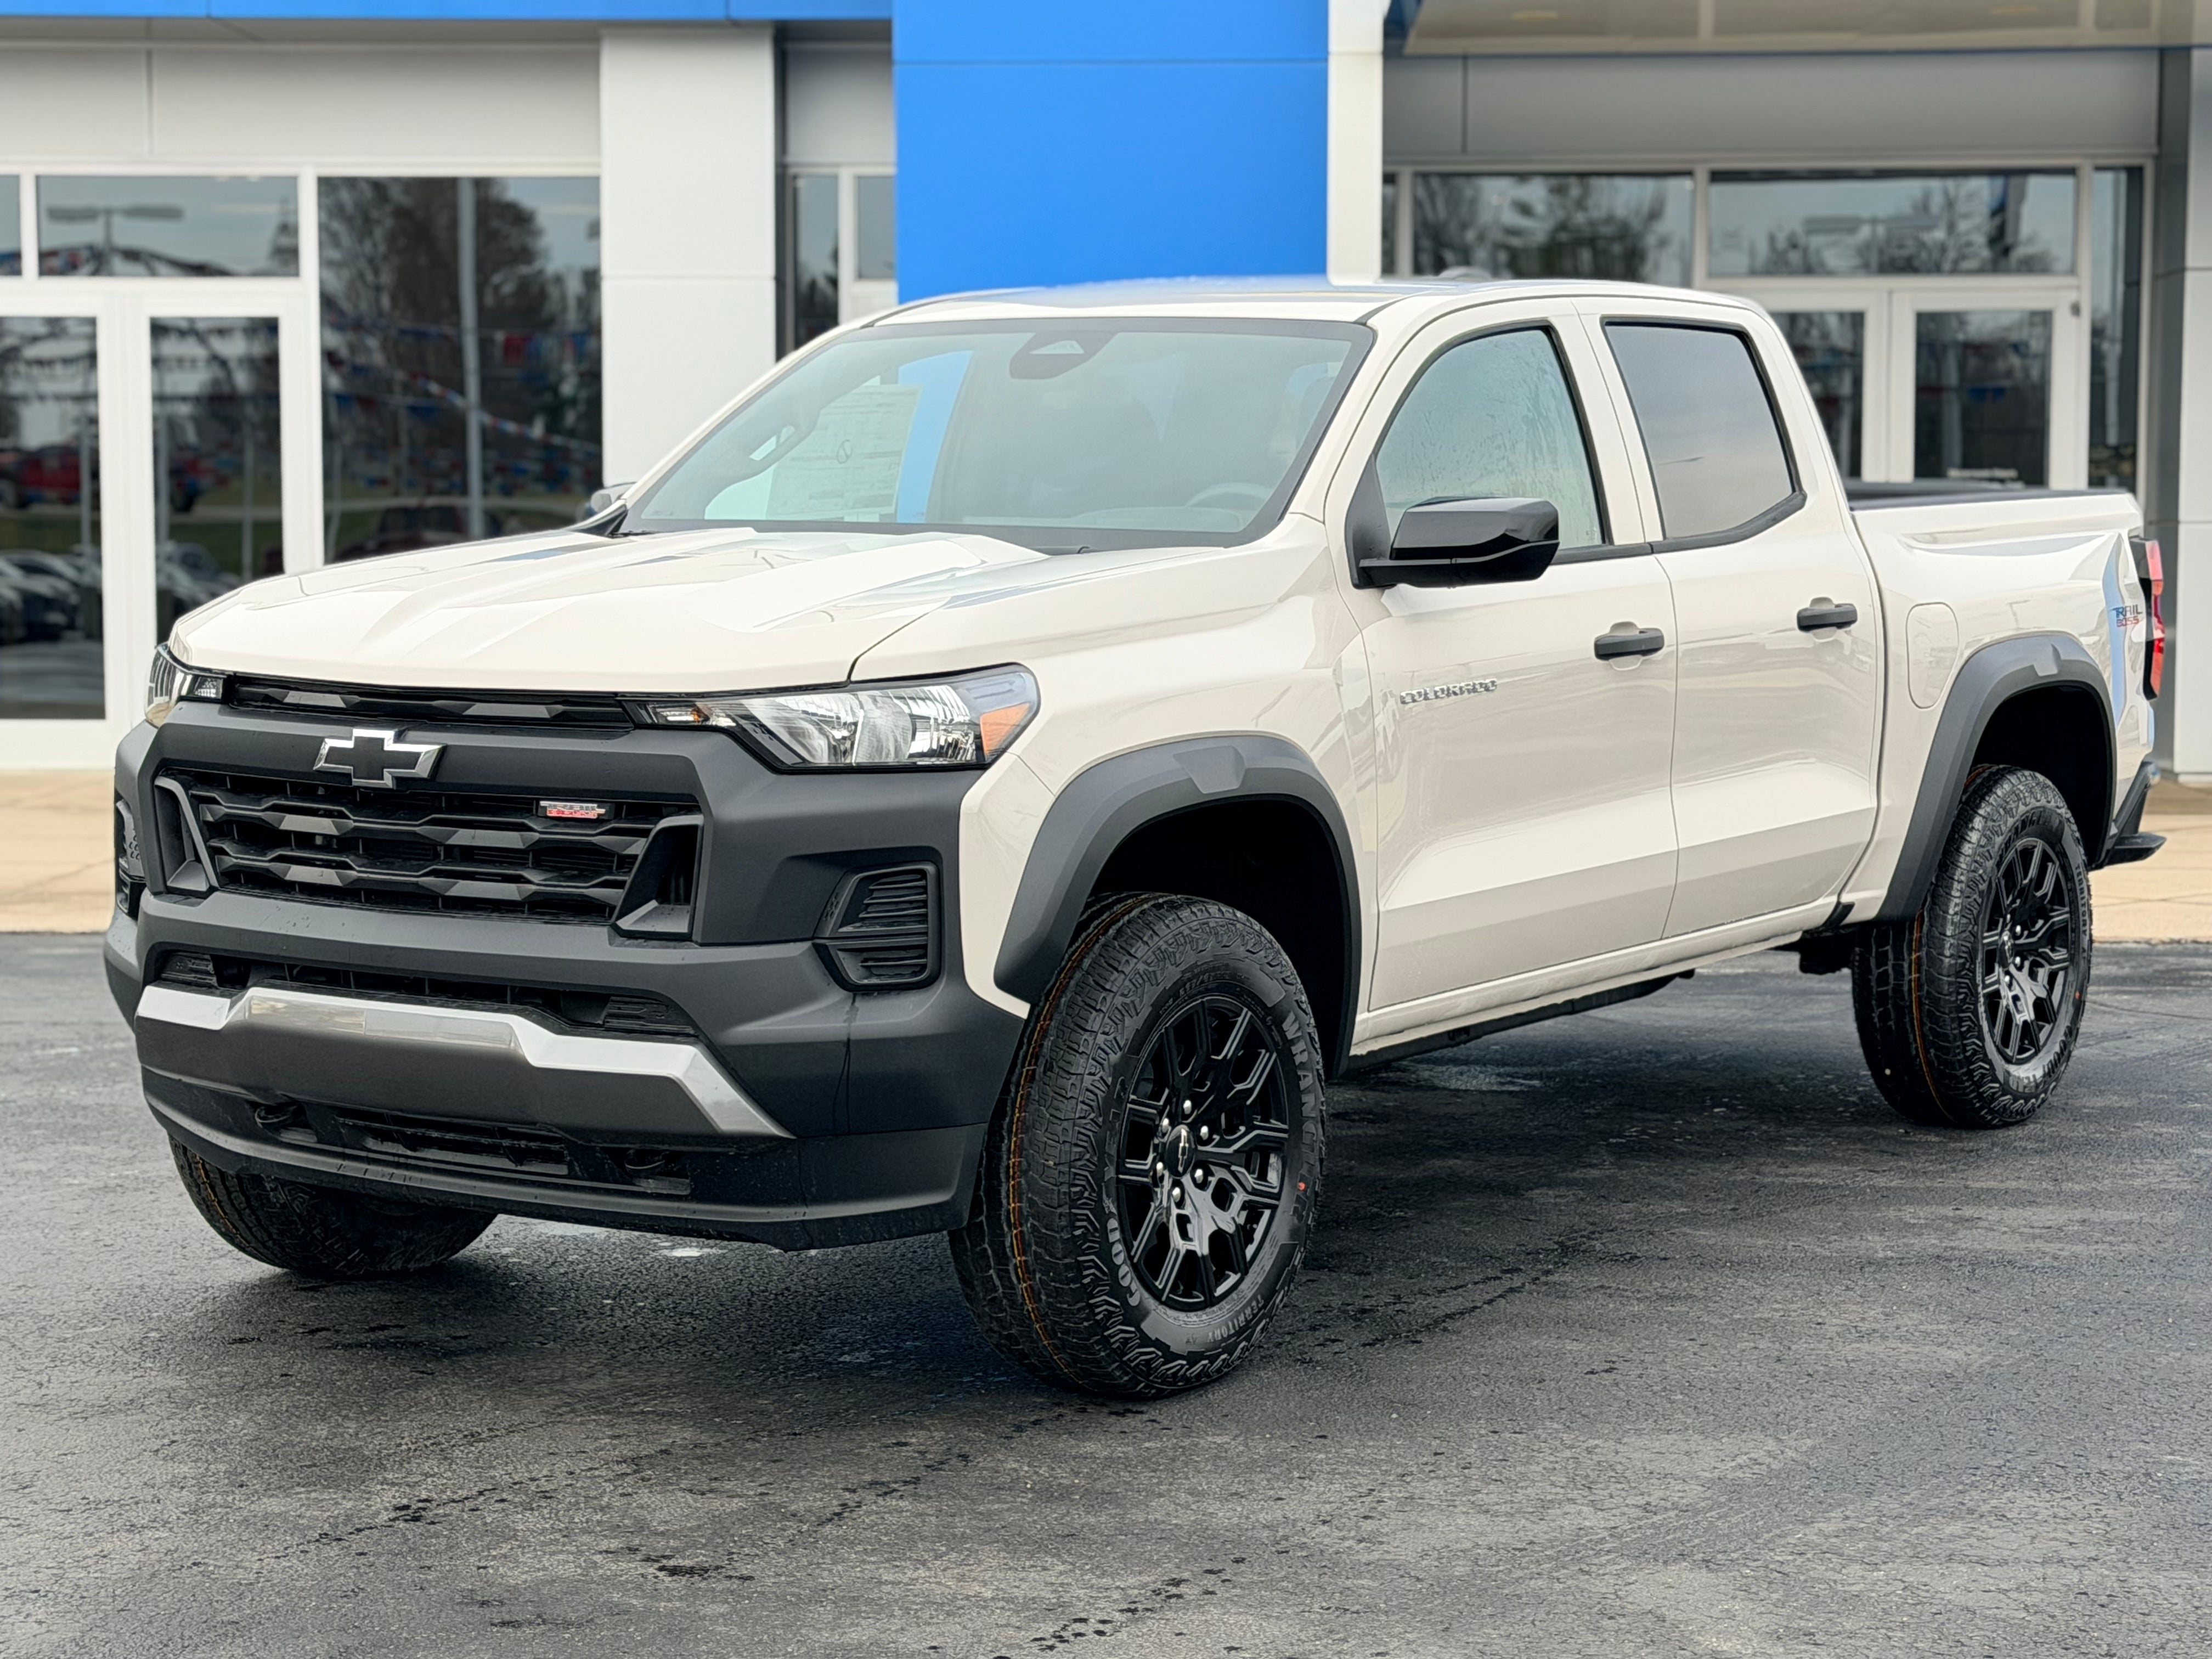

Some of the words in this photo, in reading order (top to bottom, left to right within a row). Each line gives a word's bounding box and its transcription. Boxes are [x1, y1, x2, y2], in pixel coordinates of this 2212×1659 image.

[2116, 615, 2140, 628] BOSS
[2074, 862, 2087, 936] TERRITORY
[1281, 1011, 1318, 1223] WRANGLER
[1103, 1076, 1140, 1307] GOODYEAR
[1207, 1294, 1265, 1342] TERRITORY
